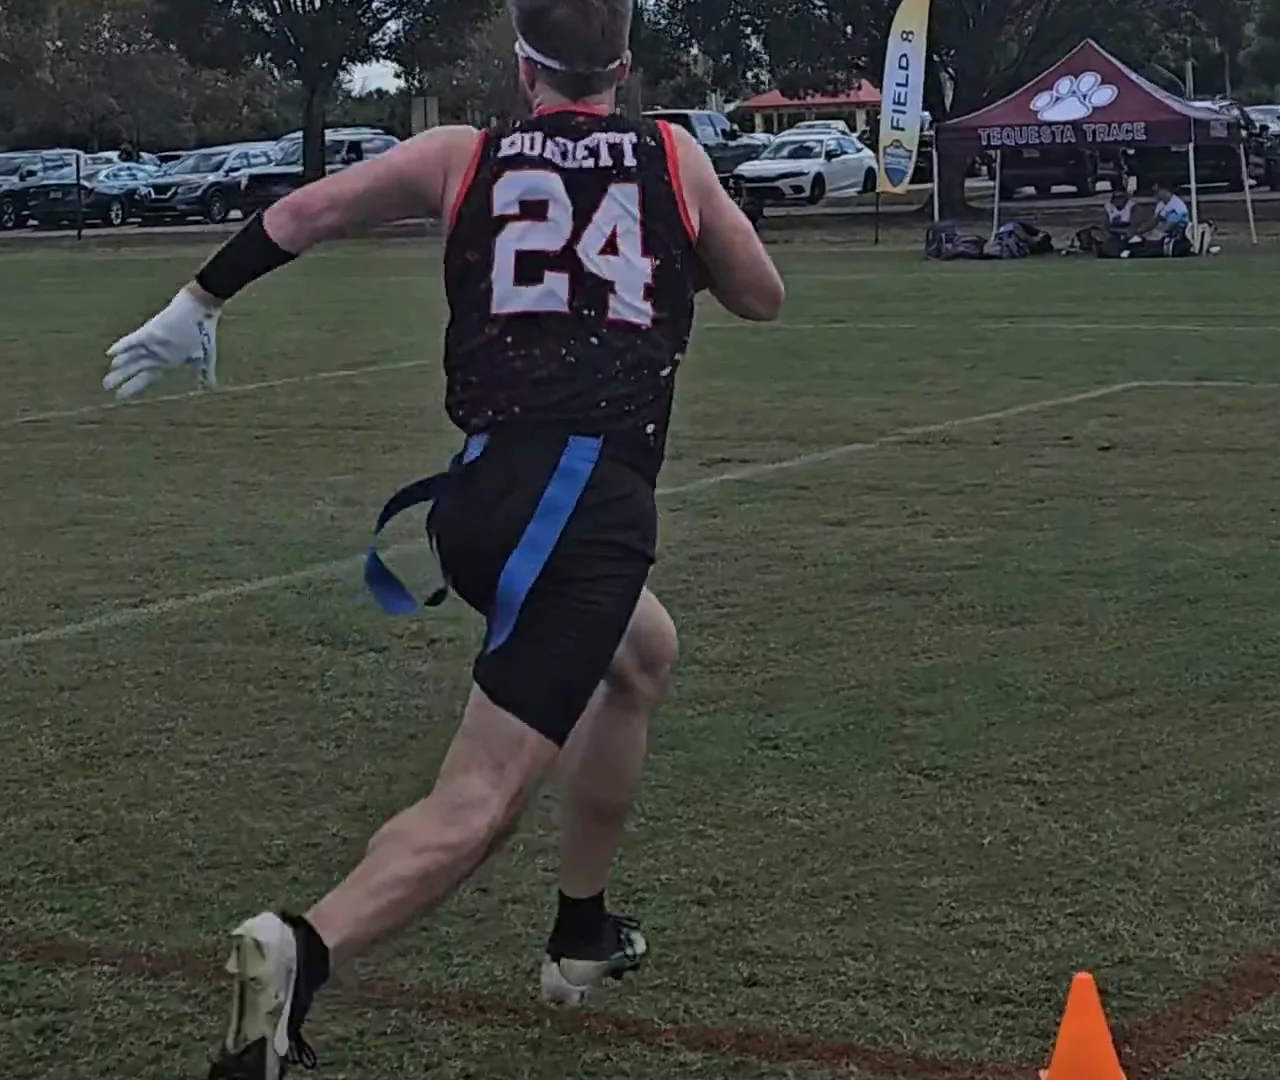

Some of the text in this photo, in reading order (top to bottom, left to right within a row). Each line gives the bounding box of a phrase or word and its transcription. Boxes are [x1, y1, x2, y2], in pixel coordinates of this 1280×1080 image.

[890, 52, 910, 132] FIELD
[900, 28, 915, 44] 8
[977, 121, 1148, 146] TEQUESTA TRACE
[489, 168, 654, 328] 24
